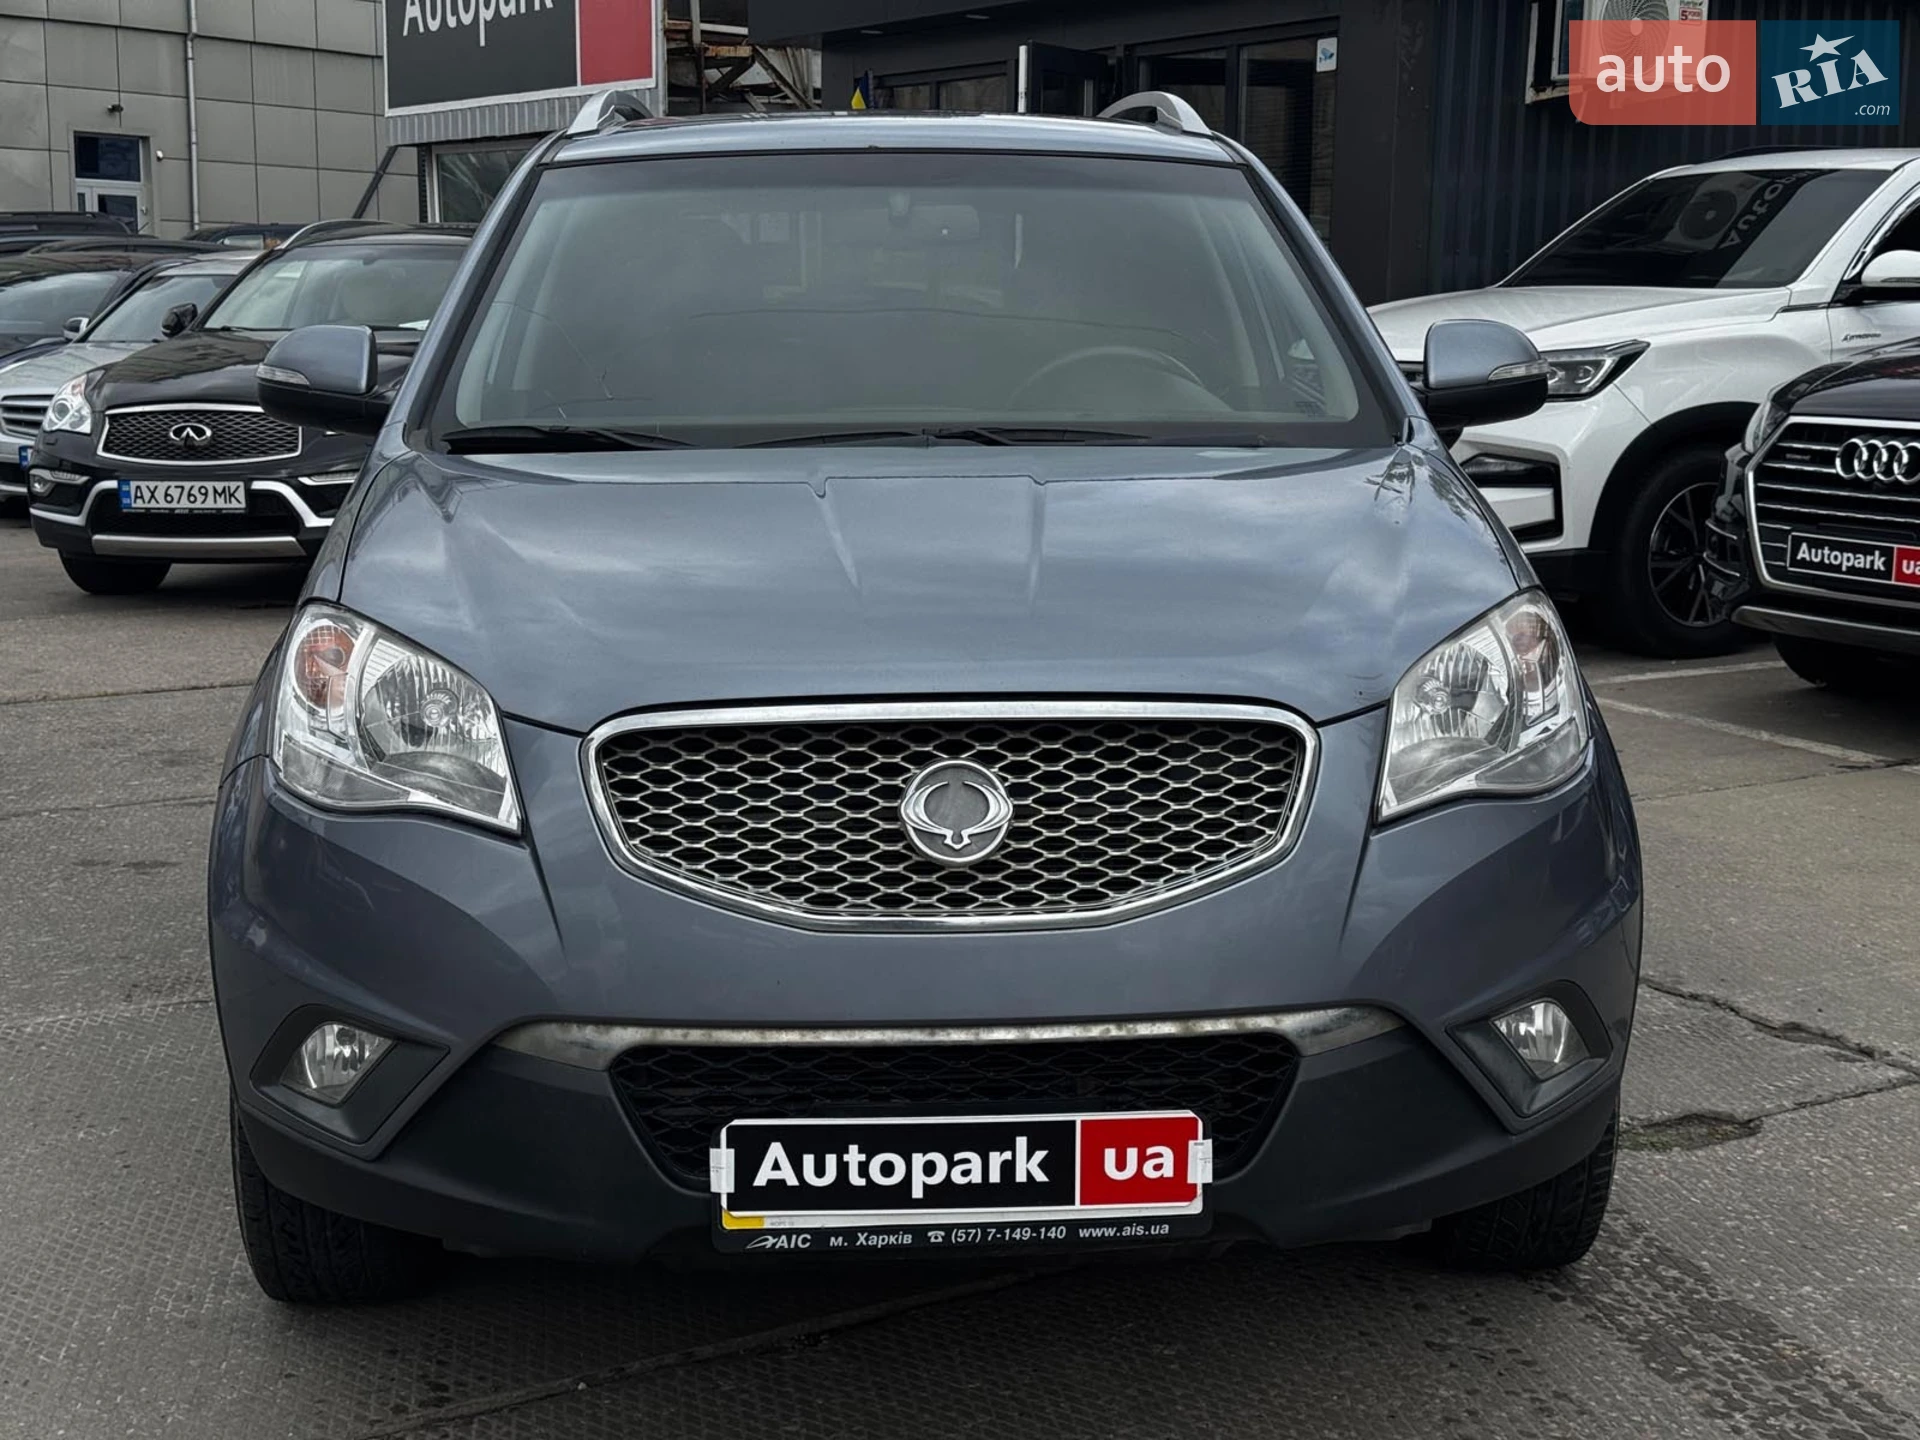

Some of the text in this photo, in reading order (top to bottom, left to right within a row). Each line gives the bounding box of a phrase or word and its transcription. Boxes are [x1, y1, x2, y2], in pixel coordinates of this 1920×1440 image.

[133, 485, 242, 504] AX 6769 MK
[1796, 541, 1886, 572] Autopark
[752, 1136, 1174, 1199] Autopark ua
[856, 1231, 913, 1248] Харків
[951, 1229, 982, 1243] (57)
[986, 1226, 1067, 1241] 7-149-140
[1078, 1224, 1170, 1238] www.ais.ua
